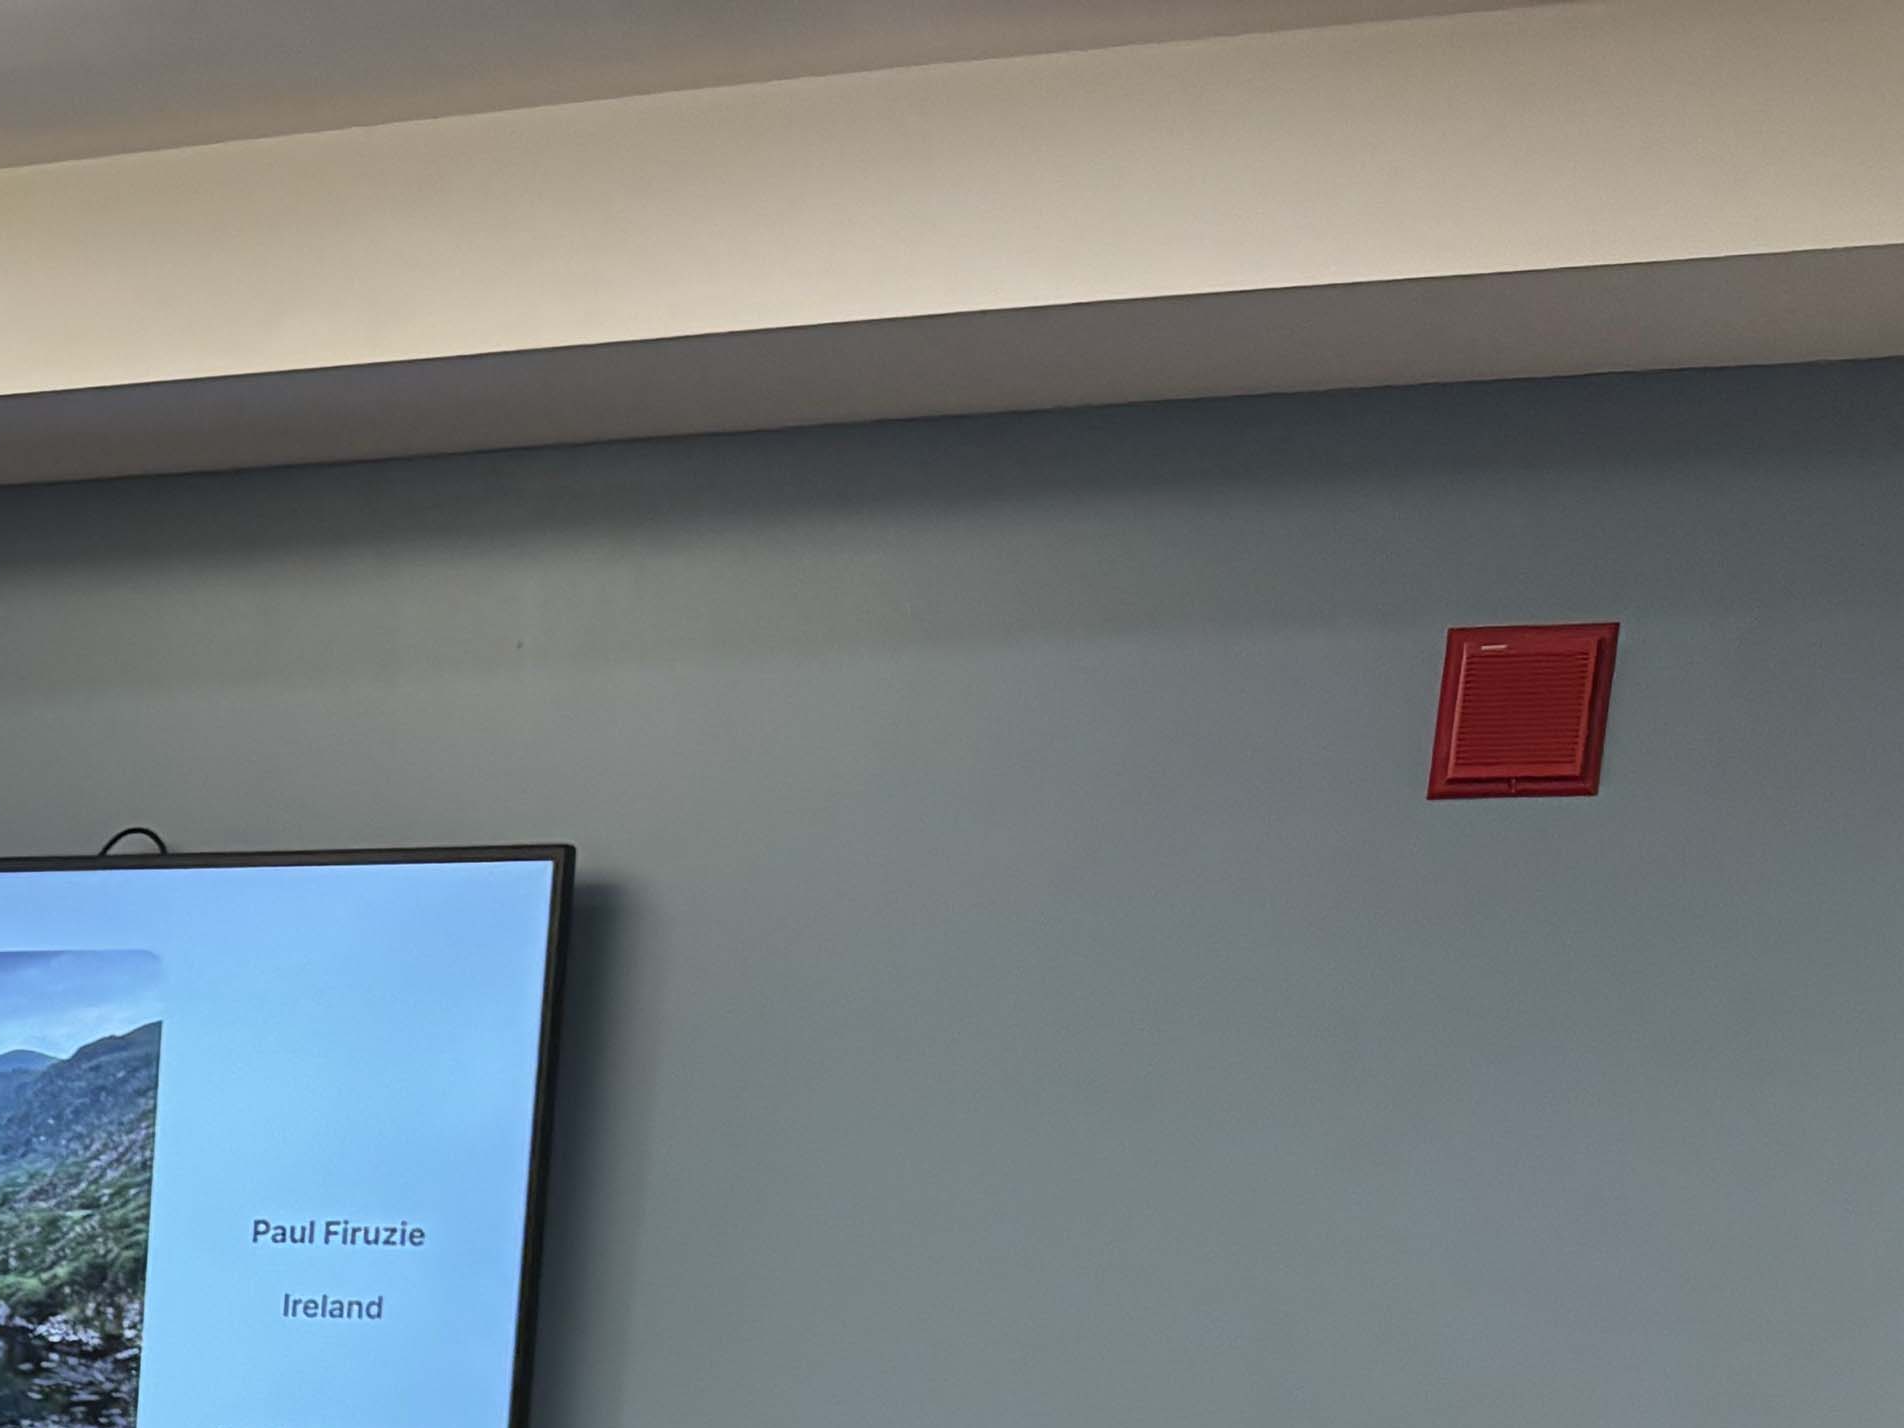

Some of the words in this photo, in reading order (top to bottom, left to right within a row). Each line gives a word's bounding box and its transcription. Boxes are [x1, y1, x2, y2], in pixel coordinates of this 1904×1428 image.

[252, 1219, 316, 1244] Paul
[323, 1220, 426, 1247] Firuzie
[282, 1293, 384, 1320] Ireland
